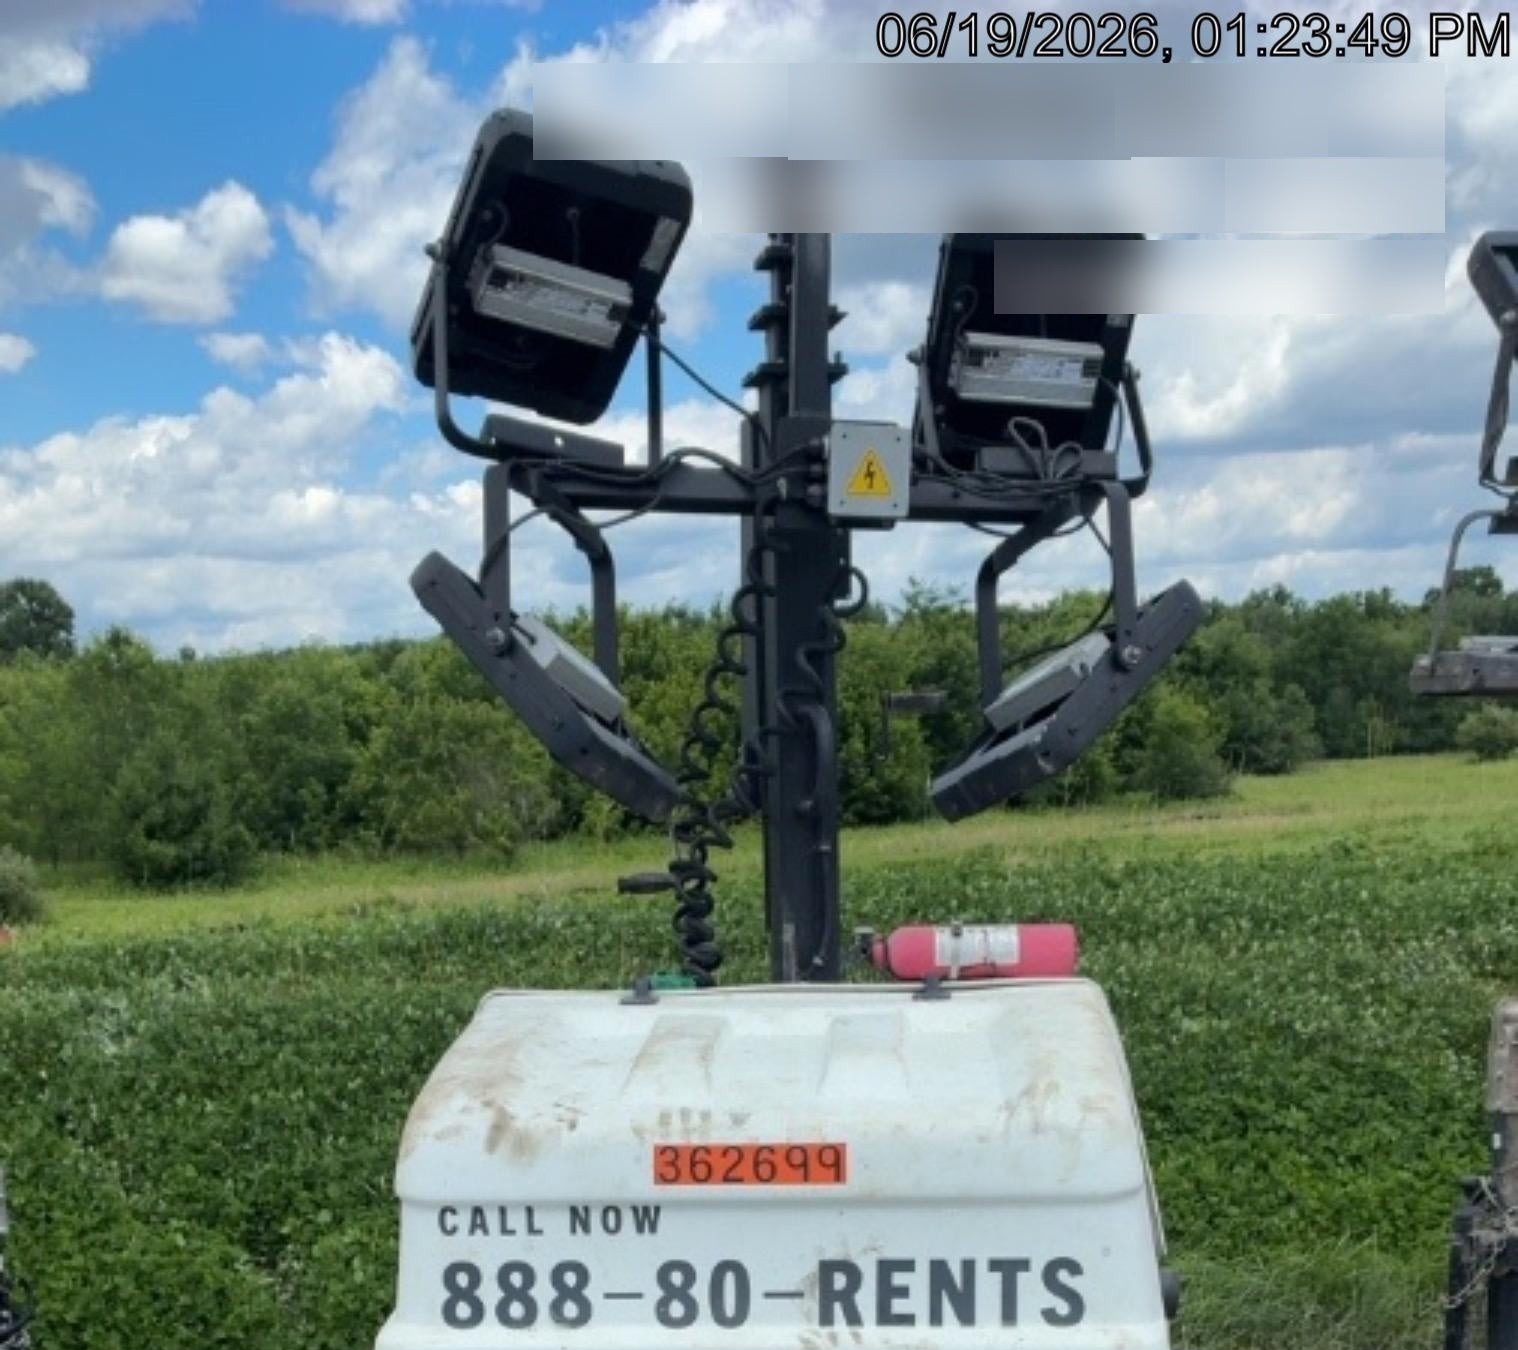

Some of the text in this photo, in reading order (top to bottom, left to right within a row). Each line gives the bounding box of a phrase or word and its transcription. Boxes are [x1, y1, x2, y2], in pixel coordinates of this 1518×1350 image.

[658, 1145, 843, 1184] 362699
[438, 1205, 662, 1236] CALL NOW
[441, 1257, 1086, 1329] 888-80-RENTS
